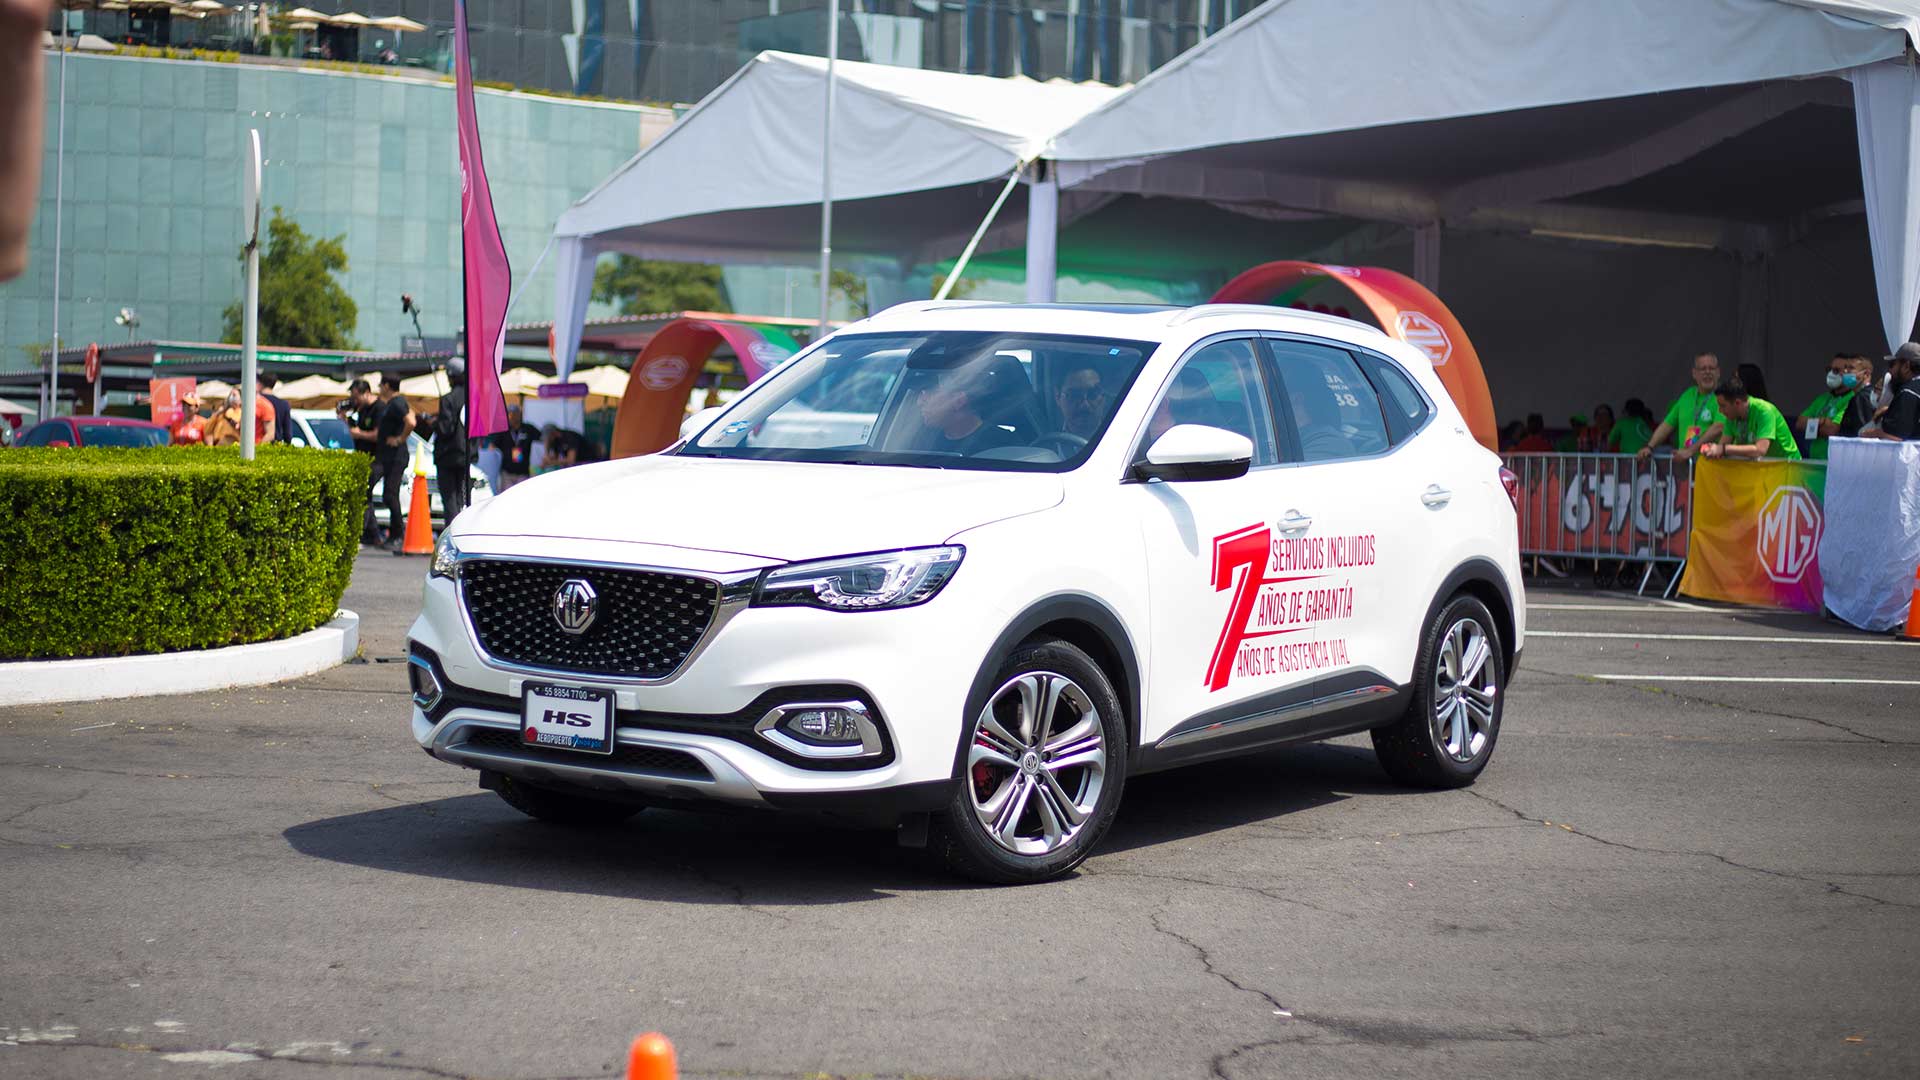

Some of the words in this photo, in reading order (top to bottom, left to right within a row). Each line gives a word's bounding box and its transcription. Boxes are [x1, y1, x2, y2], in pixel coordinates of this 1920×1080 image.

[1272, 537, 1324, 572] SERVICIOS
[1327, 534, 1376, 569] INCLUIDOS
[1761, 493, 1815, 575] MG
[555, 583, 591, 629] MG
[1203, 521, 1271, 693] 7
[1257, 586, 1286, 627] AÑOS
[1289, 591, 1304, 624] DE
[1305, 579, 1353, 623] GARANTÍA
[1236, 643, 1261, 678] AÑOS
[1264, 646, 1276, 674] DE
[1278, 641, 1329, 672] ASISTENCIA
[1330, 638, 1351, 667] VIAL
[544, 687, 553, 696] 55
[570, 689, 588, 700] 7700
[543, 709, 592, 728] HS
[537, 733, 572, 747] AEROPUERTO
